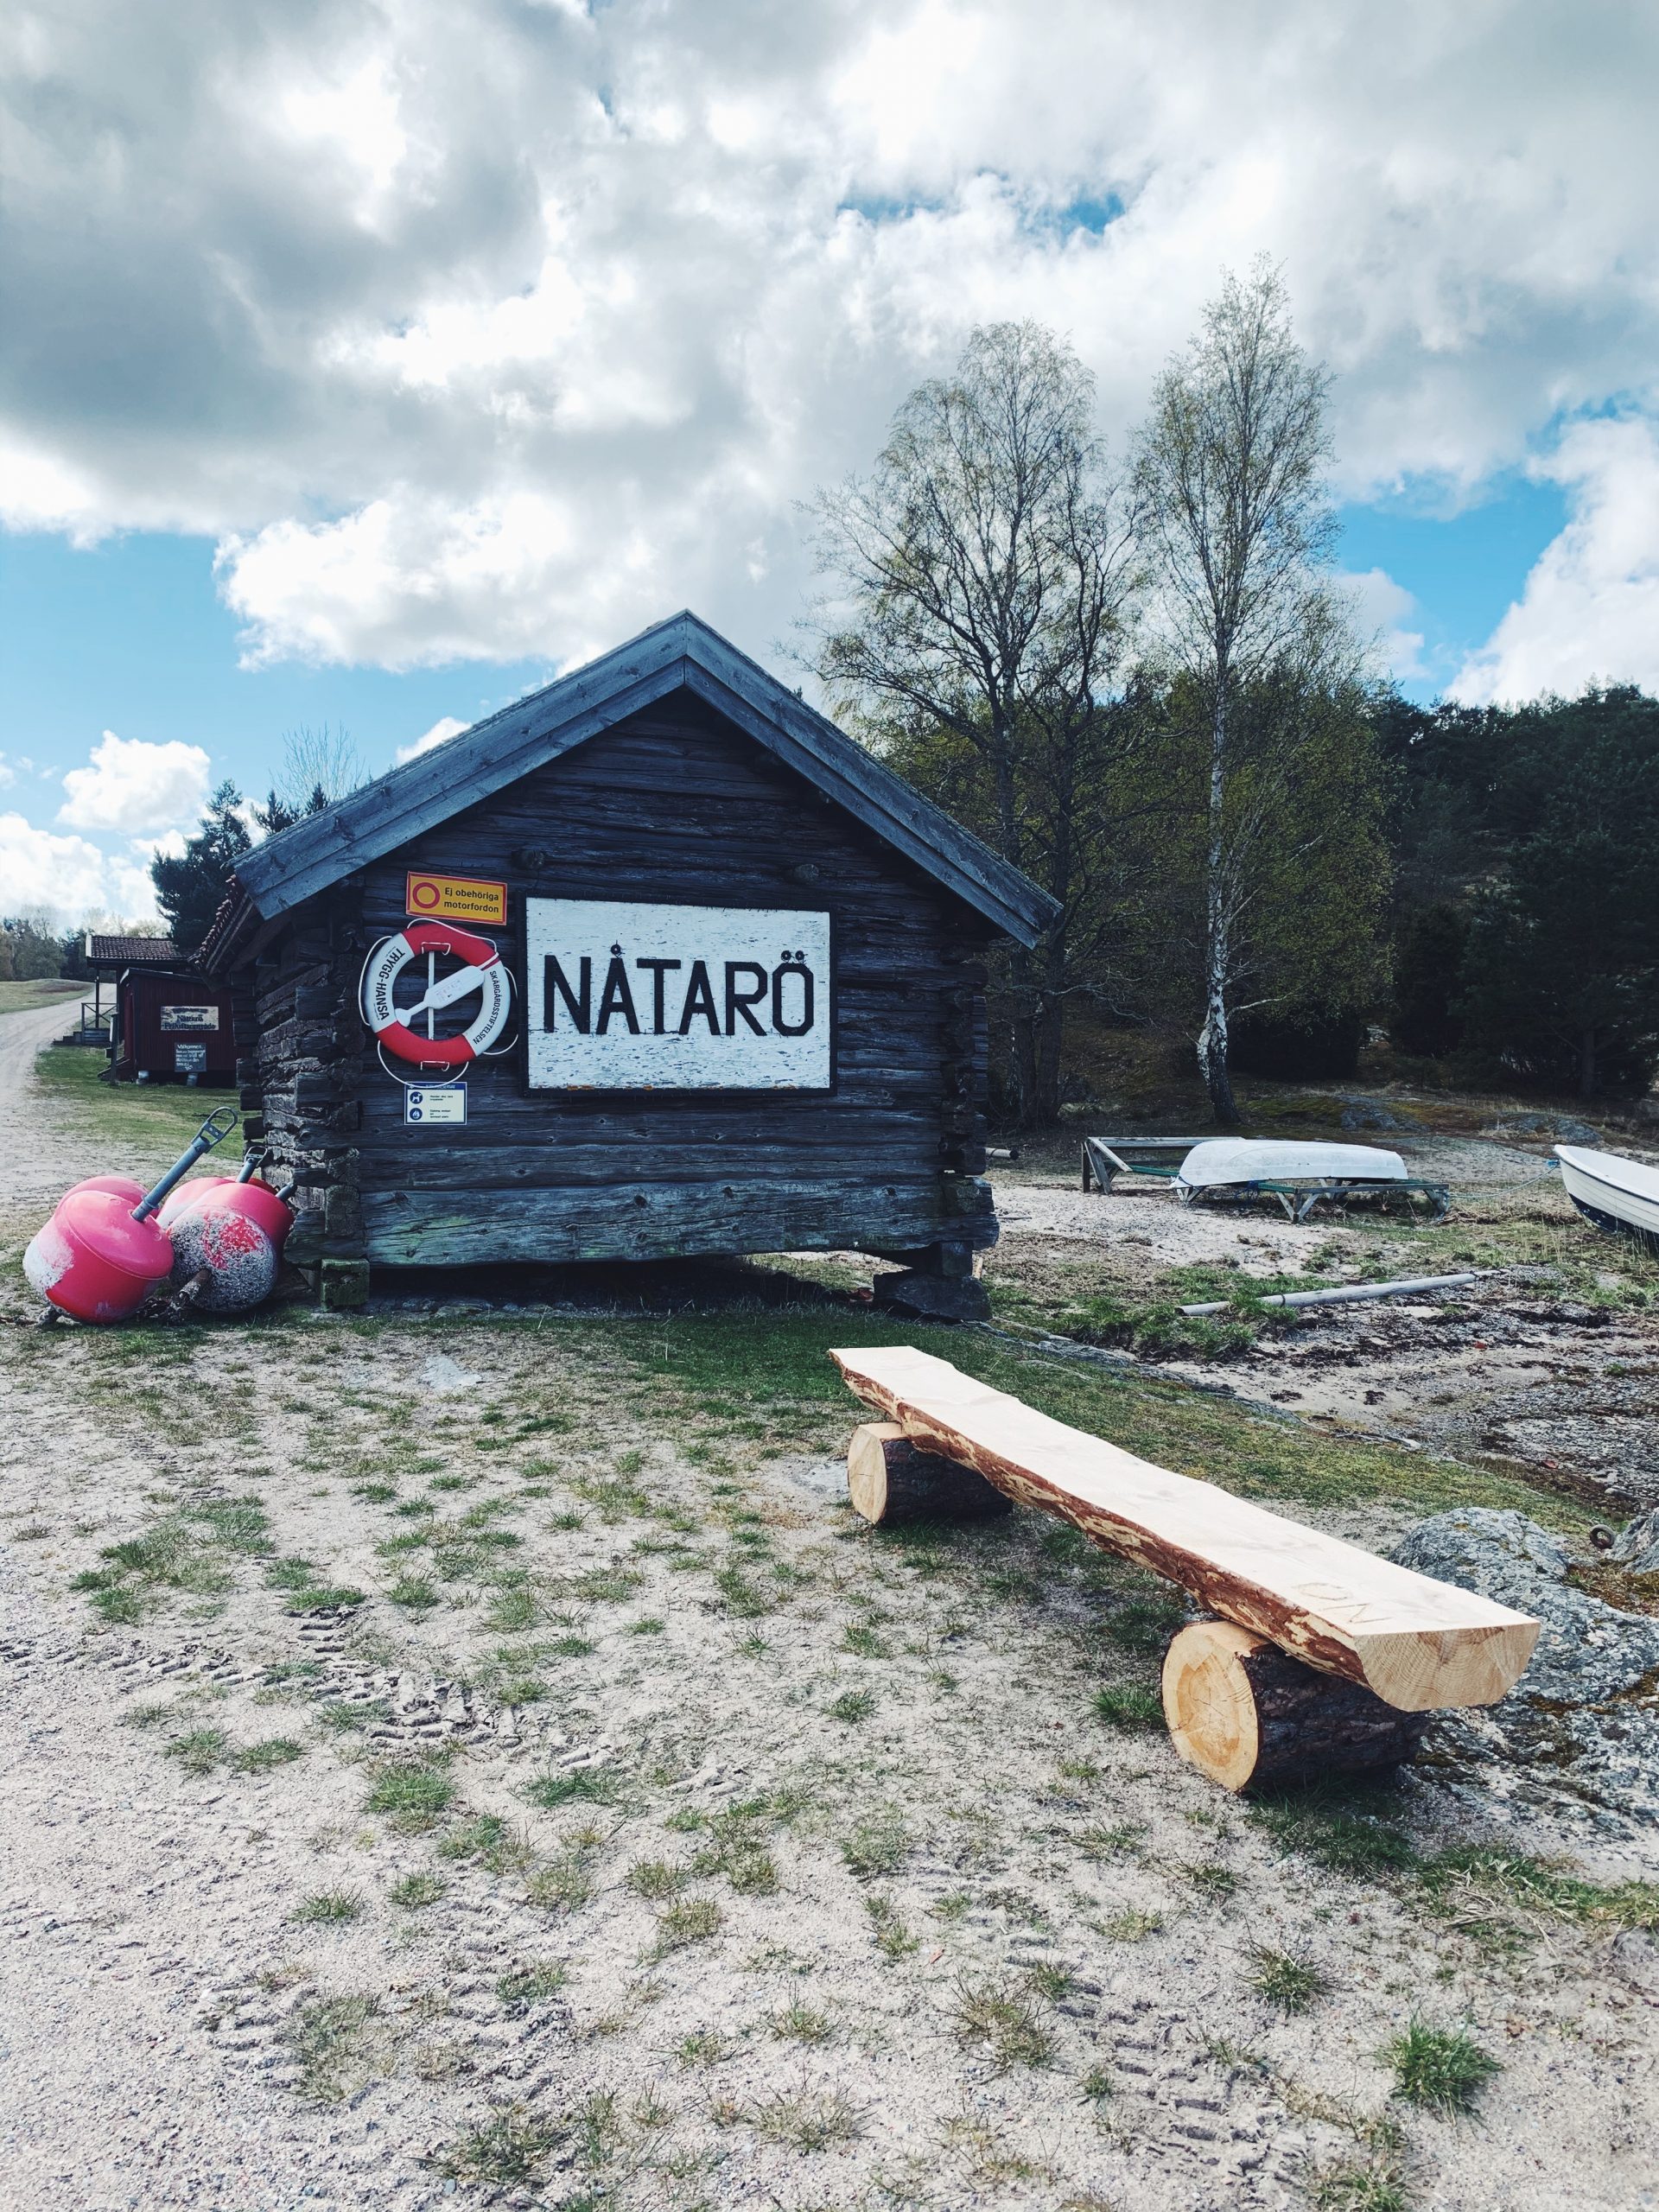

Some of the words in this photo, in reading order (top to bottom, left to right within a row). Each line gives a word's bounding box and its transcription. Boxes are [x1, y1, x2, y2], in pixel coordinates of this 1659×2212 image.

[443, 900, 499, 913] motorfordon
[444, 887, 453, 897] Ej
[455, 888, 499, 902] obehöriga
[375, 948, 406, 1020] TRYGG-HANSA
[543, 943, 815, 1037] NÅTARÖ
